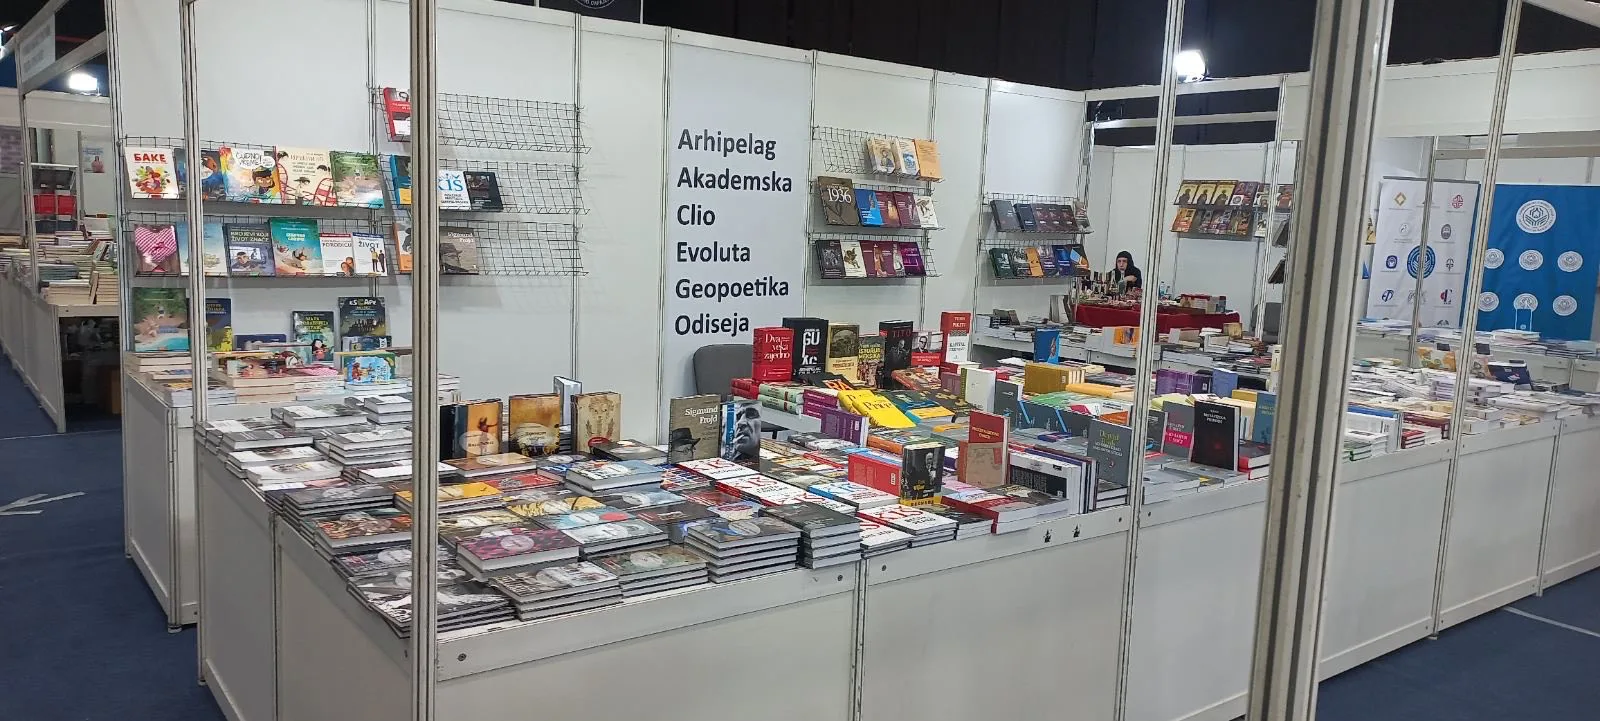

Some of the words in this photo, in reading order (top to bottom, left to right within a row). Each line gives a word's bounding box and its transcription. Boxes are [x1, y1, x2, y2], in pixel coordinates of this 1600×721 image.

[677, 129, 777, 160] Arhipelag
[134, 153, 167, 162] БАКЕ
[677, 166, 792, 192] Akademska
[827, 188, 852, 204] 1936
[677, 203, 717, 226] Clio
[676, 241, 752, 263] Evoluta
[675, 276, 789, 302] Geopoetika
[674, 312, 750, 337] Odiseja
[893, 329, 912, 338] TITO
[765, 333, 781, 343] Dva
[684, 405, 719, 418] Sigmund
[699, 415, 718, 425] Frojd
